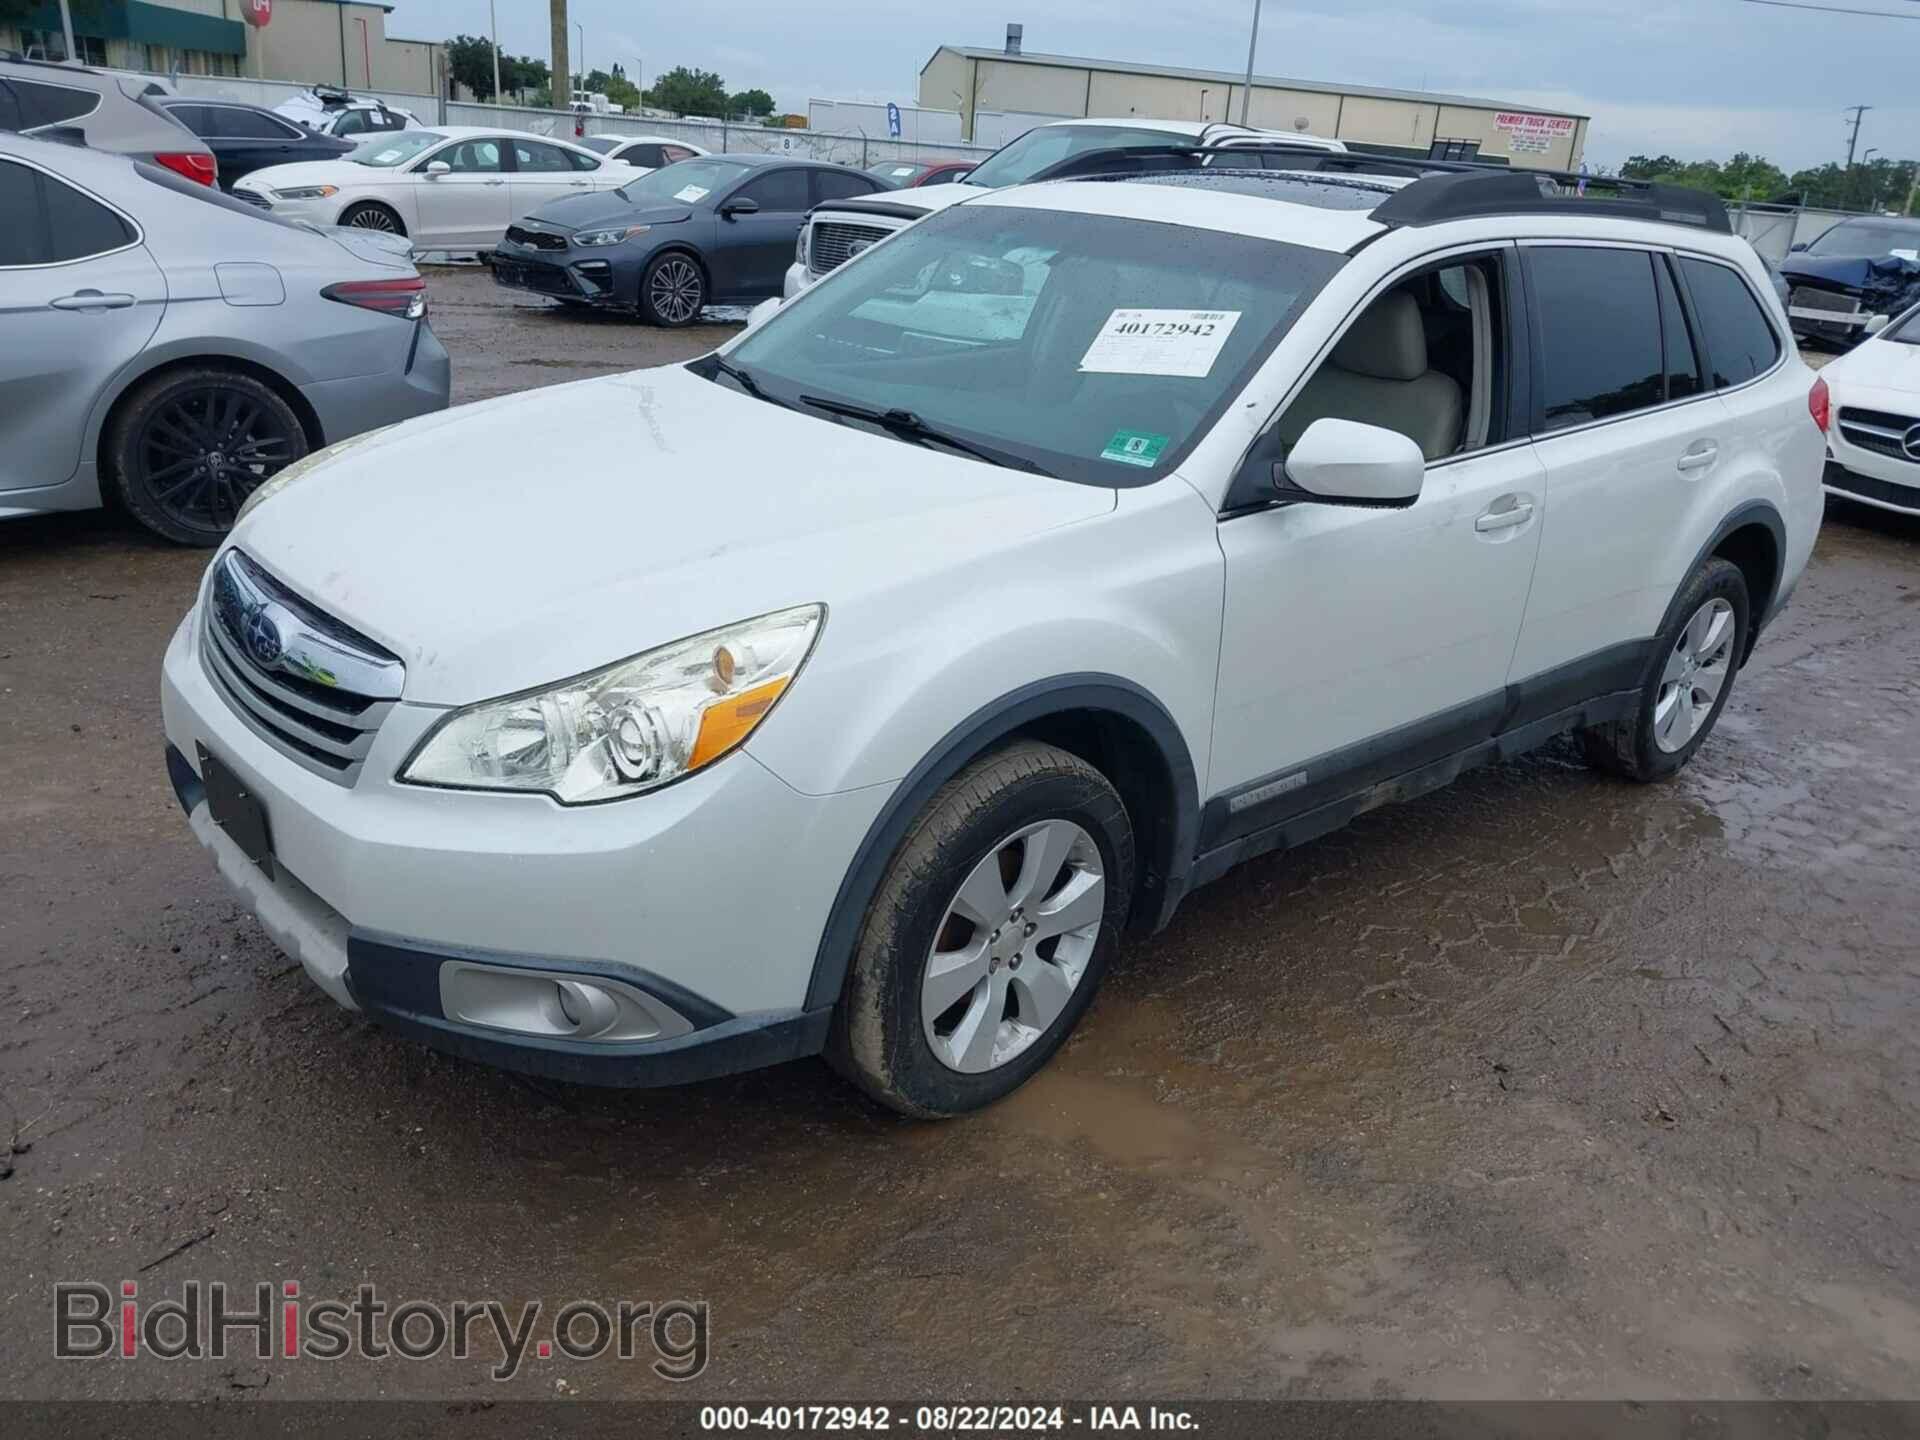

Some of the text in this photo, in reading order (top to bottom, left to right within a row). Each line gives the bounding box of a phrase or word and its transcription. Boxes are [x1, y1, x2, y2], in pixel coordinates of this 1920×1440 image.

[1496, 114, 1573, 129] PREMIER TRUCK CENTER
[1114, 322, 1216, 336] 40172942
